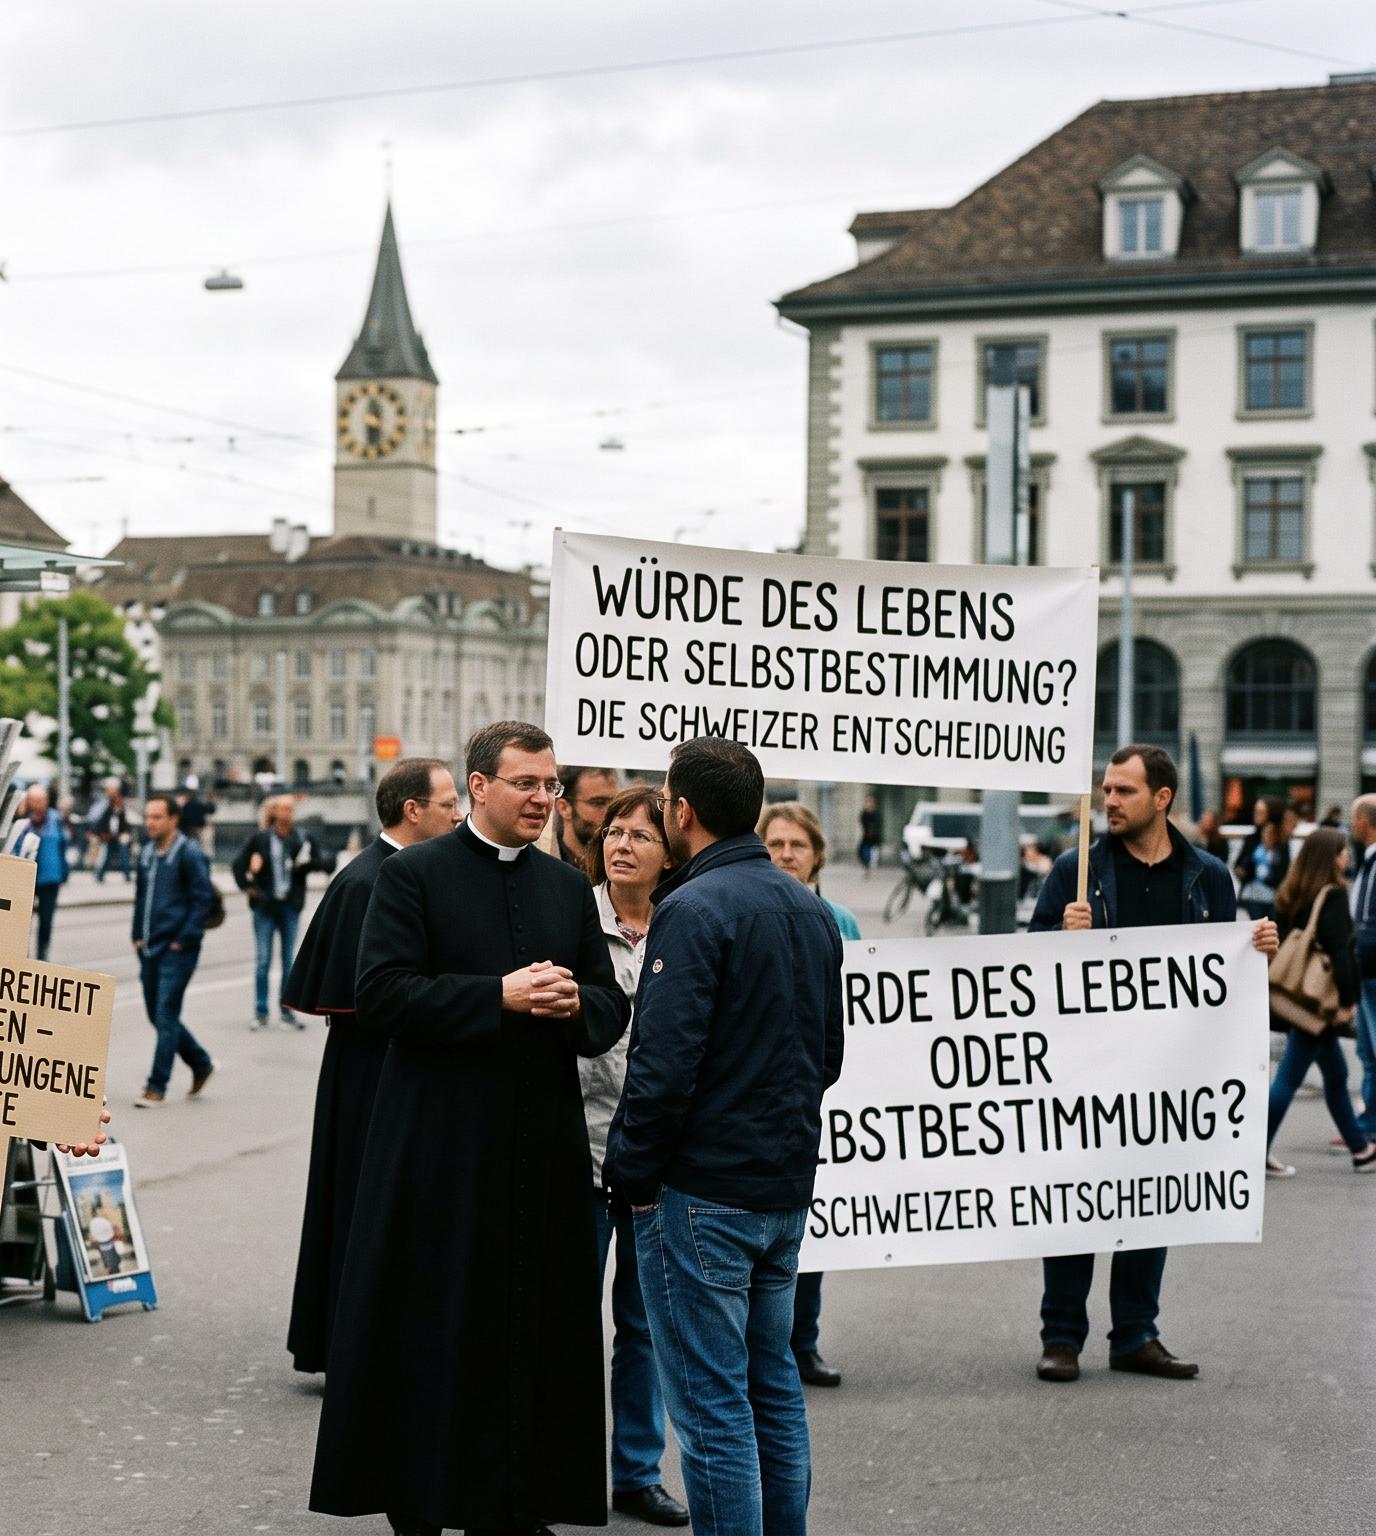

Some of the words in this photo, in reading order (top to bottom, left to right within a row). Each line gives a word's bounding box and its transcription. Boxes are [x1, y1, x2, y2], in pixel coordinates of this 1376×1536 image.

[592, 556, 744, 626] WÜRDE
[762, 578, 838, 632] DES
[857, 584, 1015, 642] LEBENS
[575, 632, 669, 683] ODER
[684, 639, 1077, 706] SELBSTBESTIMMUNG?
[577, 698, 625, 739] DIE
[638, 702, 819, 751] SCHWEIZER
[833, 714, 1067, 764] ENTSCHEIDUNG
[846, 968, 933, 1026] RDE
[951, 963, 1036, 1020] DES
[1055, 952, 1227, 1015] LEBENS
[930, 1031, 1053, 1089] ODER
[818, 1079, 1246, 1165] BSTBESTIMMUNG?
[810, 1188, 997, 1239] SCHWEIZER
[1011, 1169, 1250, 1227] ENTSCHEIDUNG
